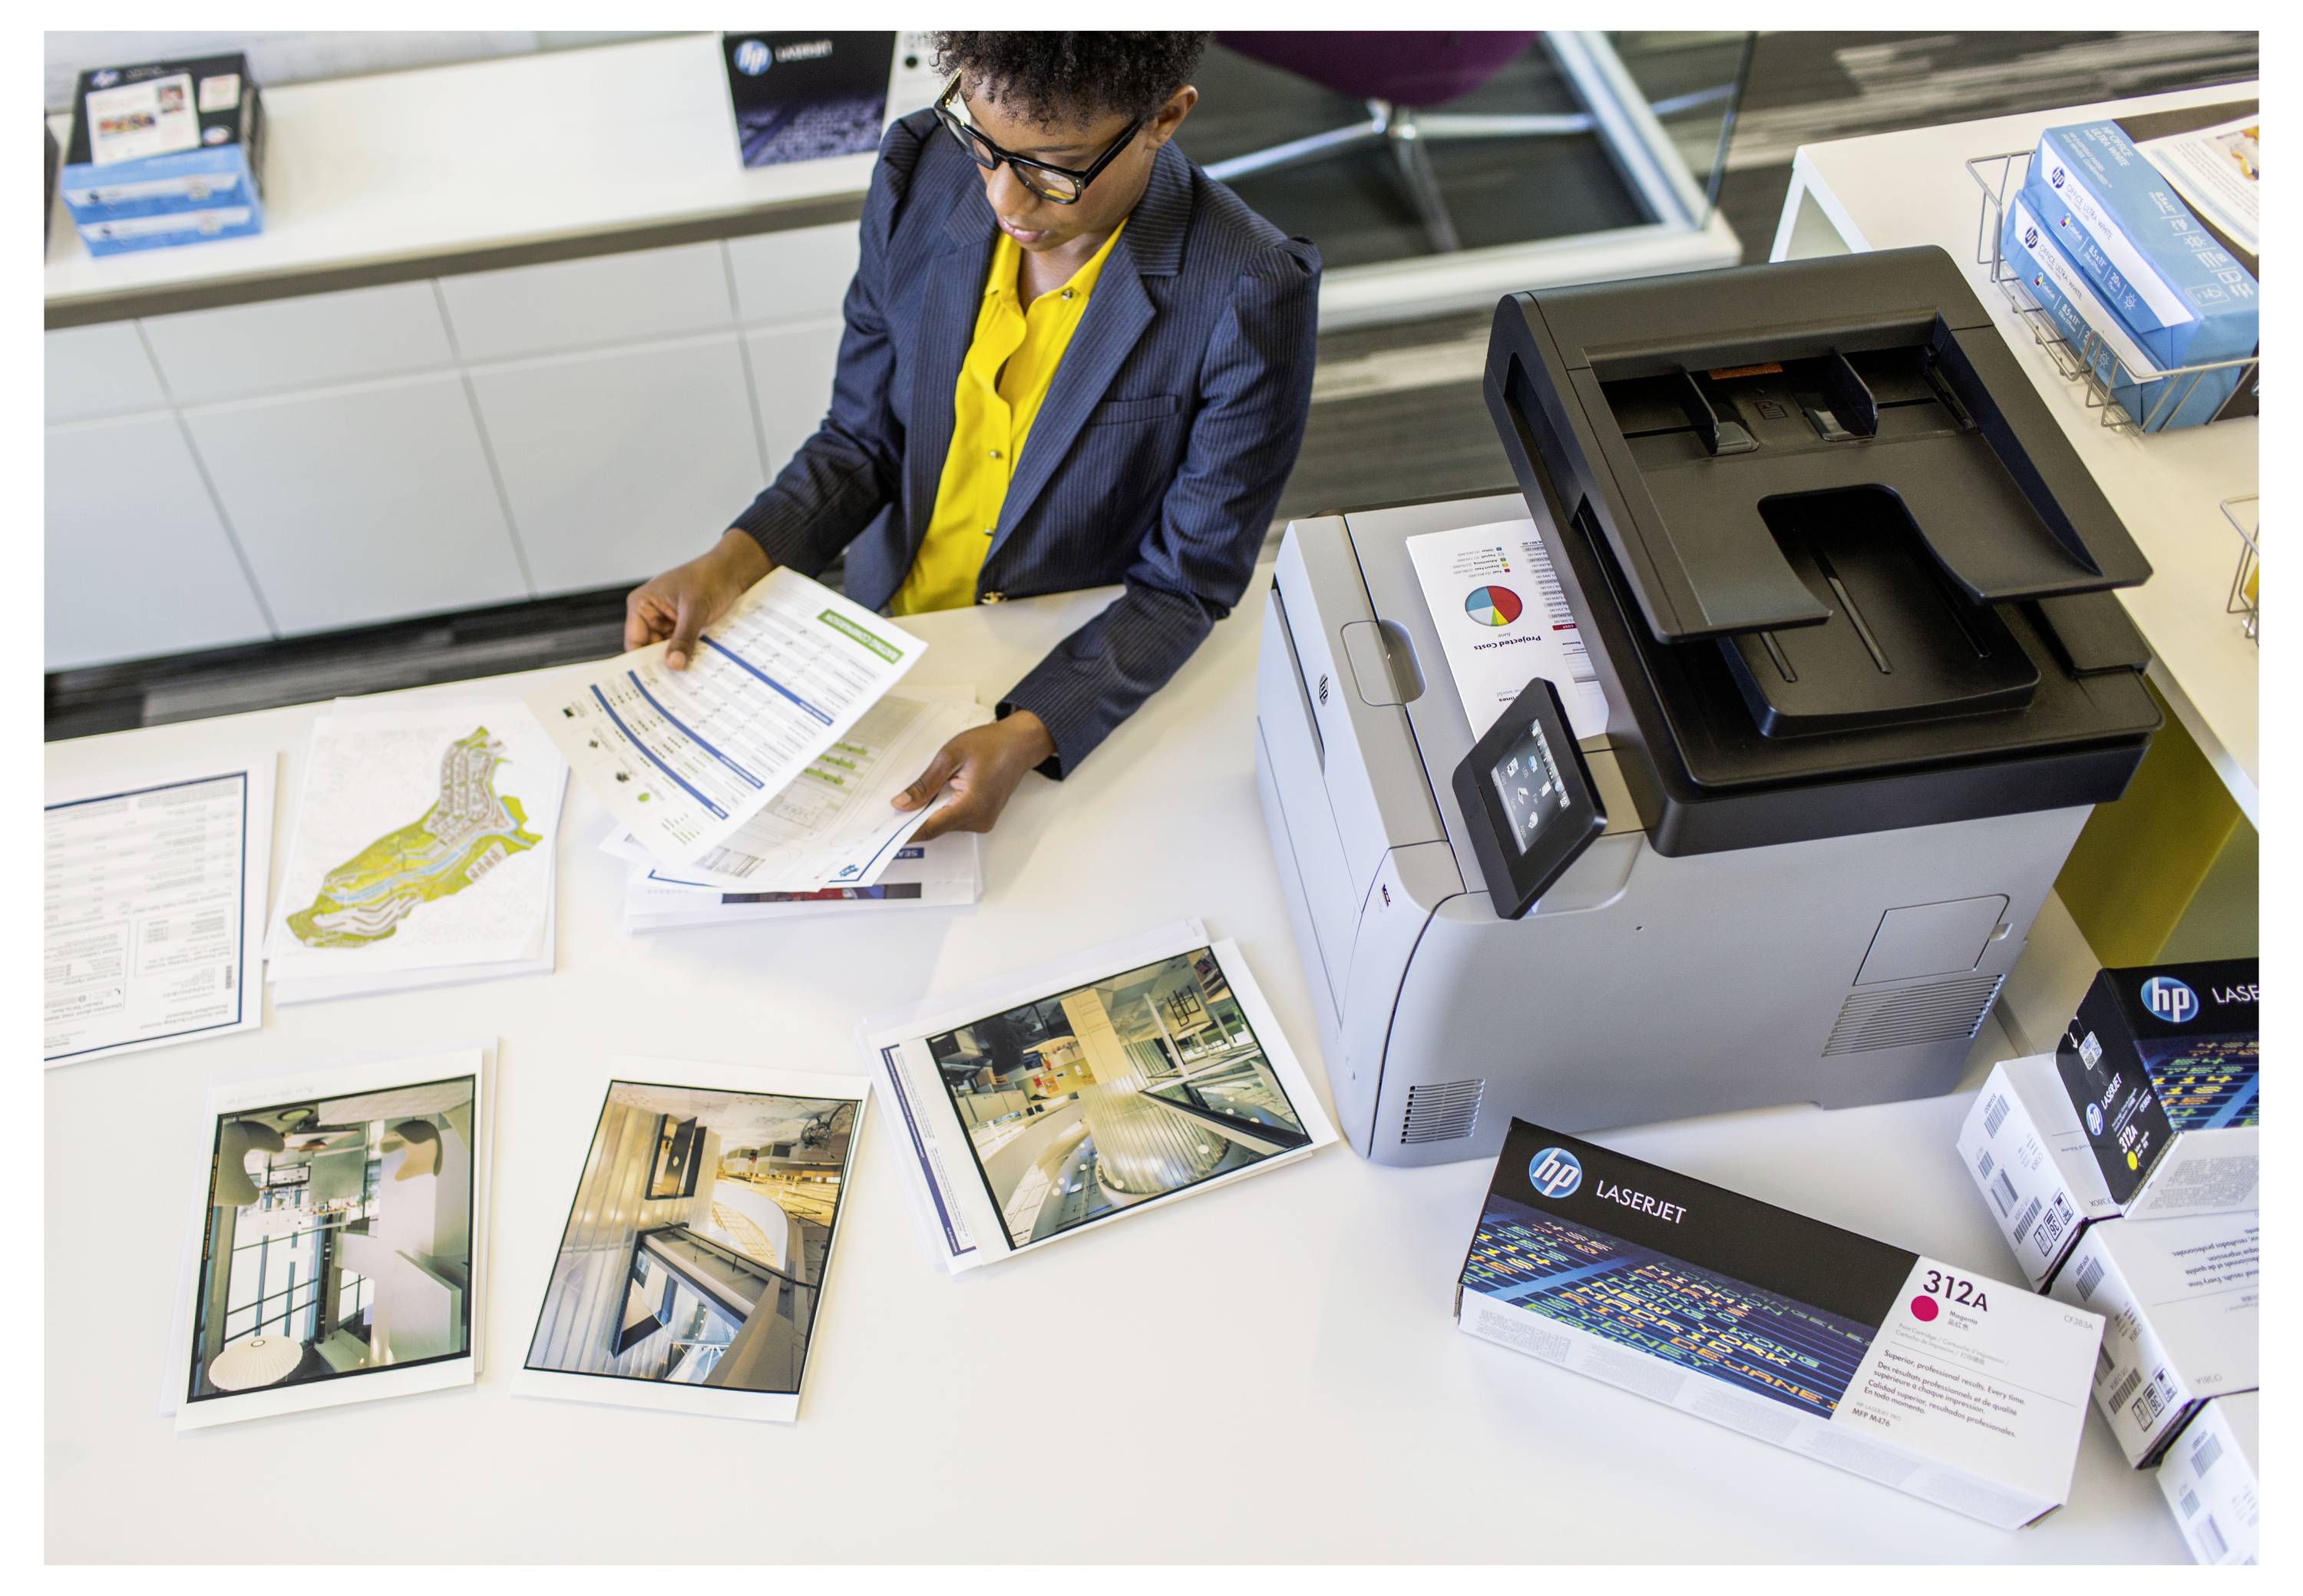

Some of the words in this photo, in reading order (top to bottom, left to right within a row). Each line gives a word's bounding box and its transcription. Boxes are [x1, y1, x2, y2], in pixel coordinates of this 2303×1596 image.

[2052, 166, 2065, 189] hp
[2024, 227, 2038, 249] hp
[1473, 641, 1497, 651] Costs
[1498, 634, 1541, 646] Projected
[1318, 673, 1330, 705] hp
[2152, 977, 2190, 1022] hp
[2101, 1073, 2122, 1110] LASERJET
[2088, 1105, 2103, 1135] hp
[2119, 1125, 2139, 1154] 312A
[1531, 1148, 1581, 1196] hp
[1596, 1180, 1687, 1224] LASERJET
[1624, 1272, 1740, 1324] TOKYO
[1633, 1267, 1749, 1320] PARIS
[1645, 1263, 1753, 1313] MIAMI
[1657, 1260, 1783, 1316] LONDON
[1923, 1270, 1989, 1312] 312A
[1558, 1289, 1644, 1330] RIO
[1574, 1284, 1735, 1356] MADRID
[1590, 1279, 1671, 1317] NEW
[1695, 1322, 1792, 1368] YORK
[1605, 1274, 1707, 1321] HONG
[1728, 1325, 1821, 1369] KONG
[1949, 1310, 1978, 1325] Magenta
[2063, 1313, 2093, 1331] CF383A
[1546, 1297, 1715, 1373] SYDNEY
[1911, 1327, 1937, 1341] Cartridge
[1941, 1337, 1971, 1353] Cartouche
[1877, 1360, 1890, 1370] Des
[1921, 1376, 1974, 1402] professionnels
[1981, 1398, 1992, 1407] de
[1883, 1349, 1916, 1367] Superior,
[1916, 1361, 1960, 1383] professional
[1961, 1376, 1987, 1391] results.
[1986, 1386, 2007, 1399] Every
[2007, 1394, 2027, 1406] time.
[1852, 1408, 1868, 1419] MFP
[1870, 1413, 1891, 1427] M476
[1863, 1386, 1872, 1395] En
[1872, 1389, 1889, 1401] todo
[1890, 1396, 1926, 1414] momento.
[1867, 1379, 1896, 1394] Calidad
[1896, 1390, 1928, 1407] superior,
[1928, 1401, 1966, 1419] resultados
[1966, 1415, 2017, 1439] profesionales.
[1917, 1384, 1944, 1400] chaque
[1944, 1394, 1986, 1415] impression.
